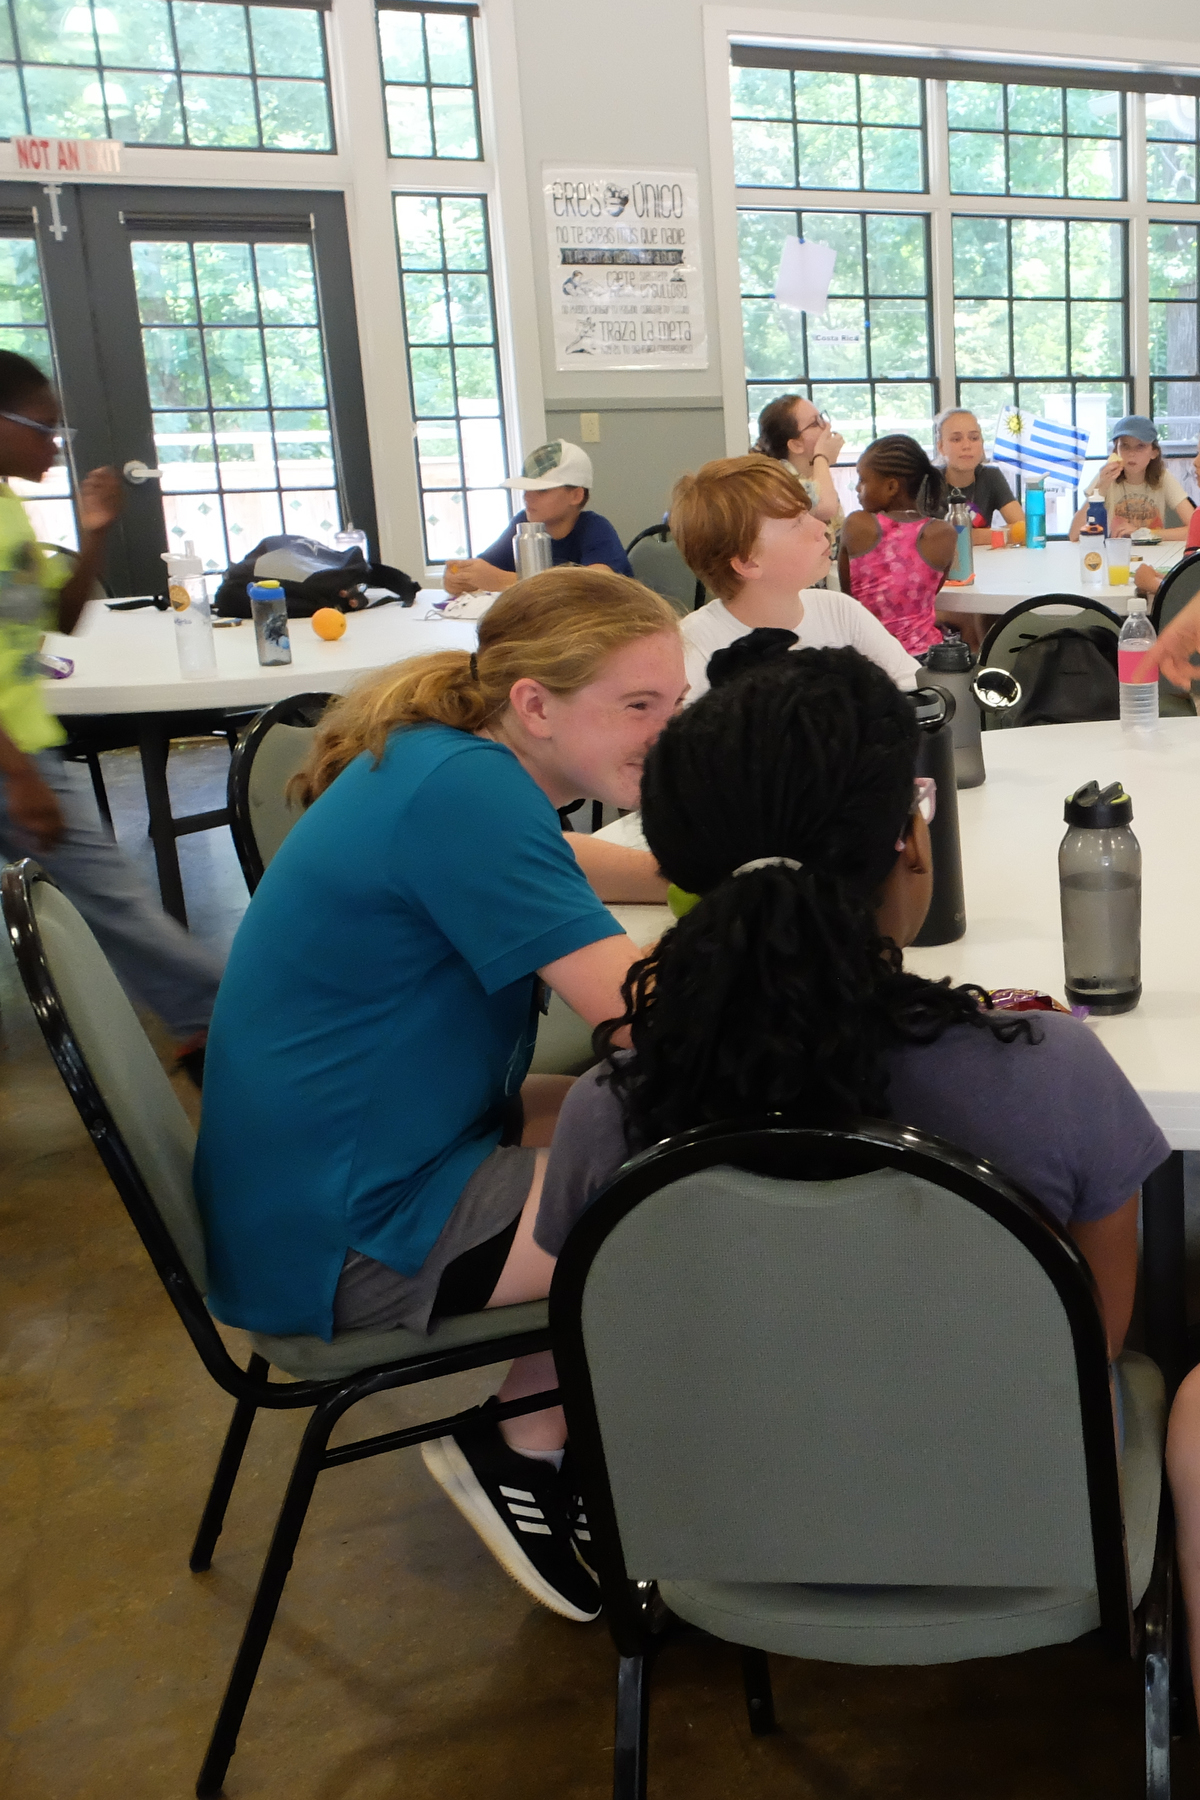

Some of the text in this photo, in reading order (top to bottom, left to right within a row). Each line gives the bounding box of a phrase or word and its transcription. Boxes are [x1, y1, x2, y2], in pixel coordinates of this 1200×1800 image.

[16, 139, 121, 173] NOT AN EXIT
[841, 334, 860, 342] Rica
